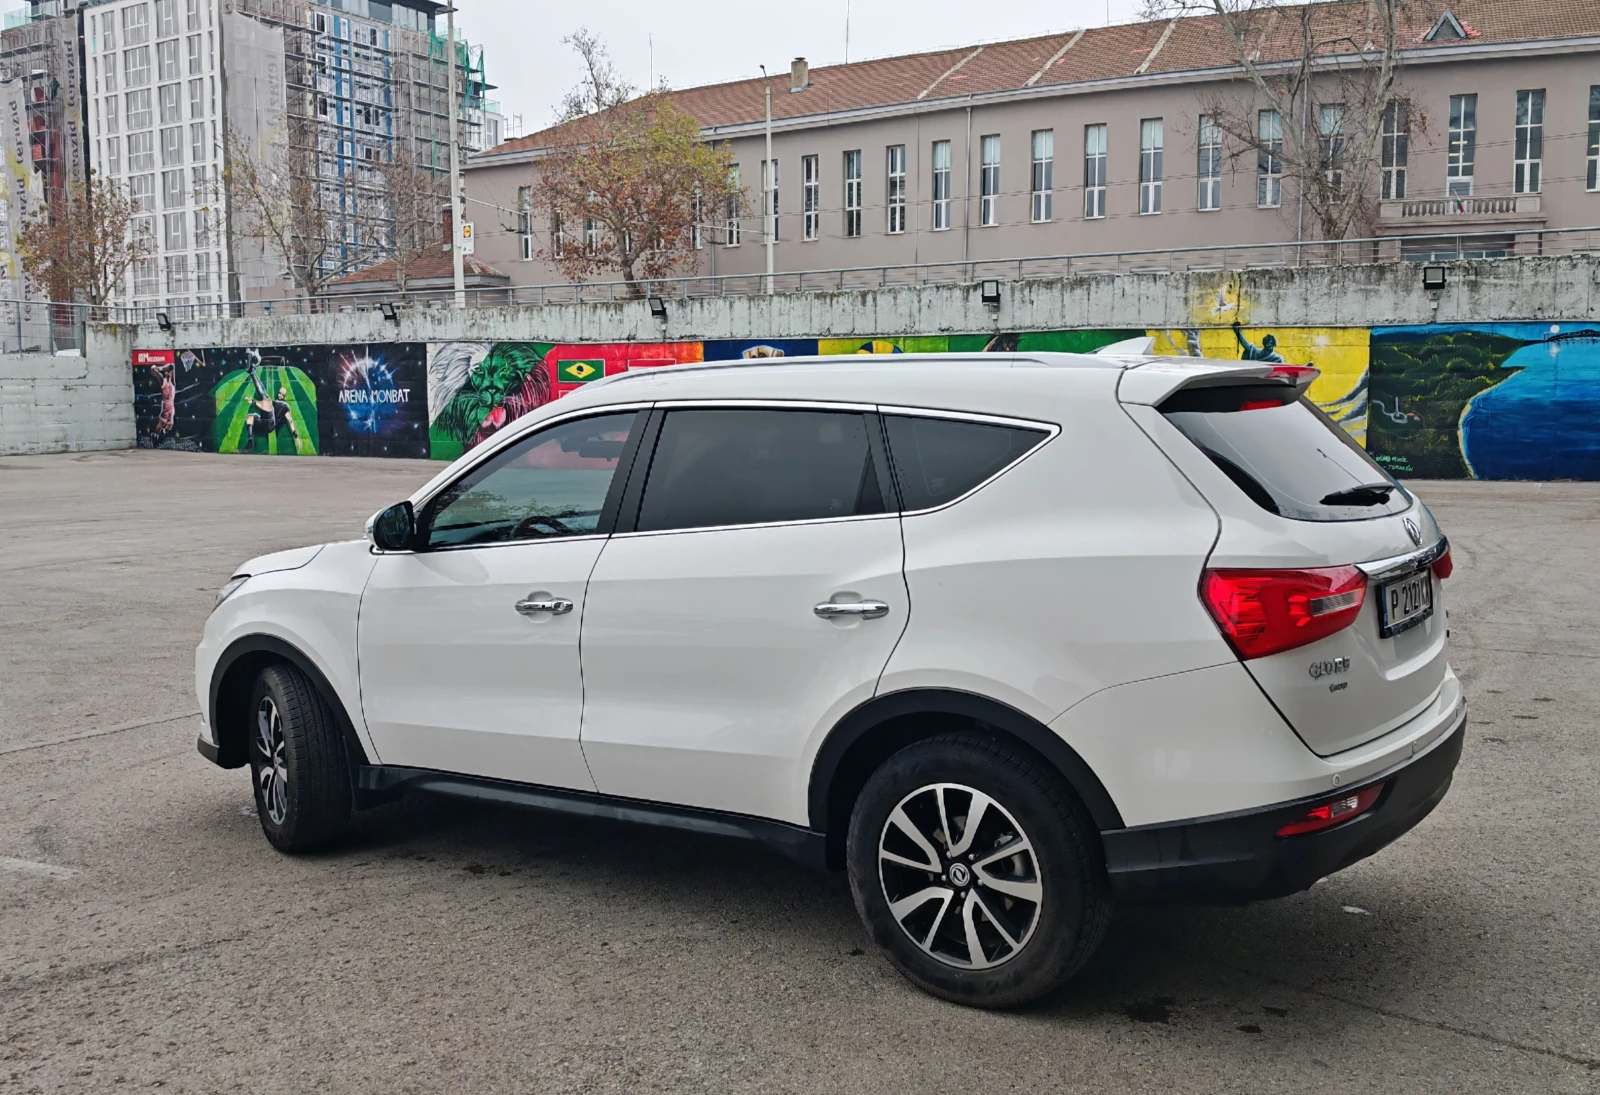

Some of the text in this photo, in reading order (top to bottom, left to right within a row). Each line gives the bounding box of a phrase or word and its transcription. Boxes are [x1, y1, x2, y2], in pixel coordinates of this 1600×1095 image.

[338, 388, 411, 404] ARENA MONBAT
[1391, 588, 1399, 620] P
